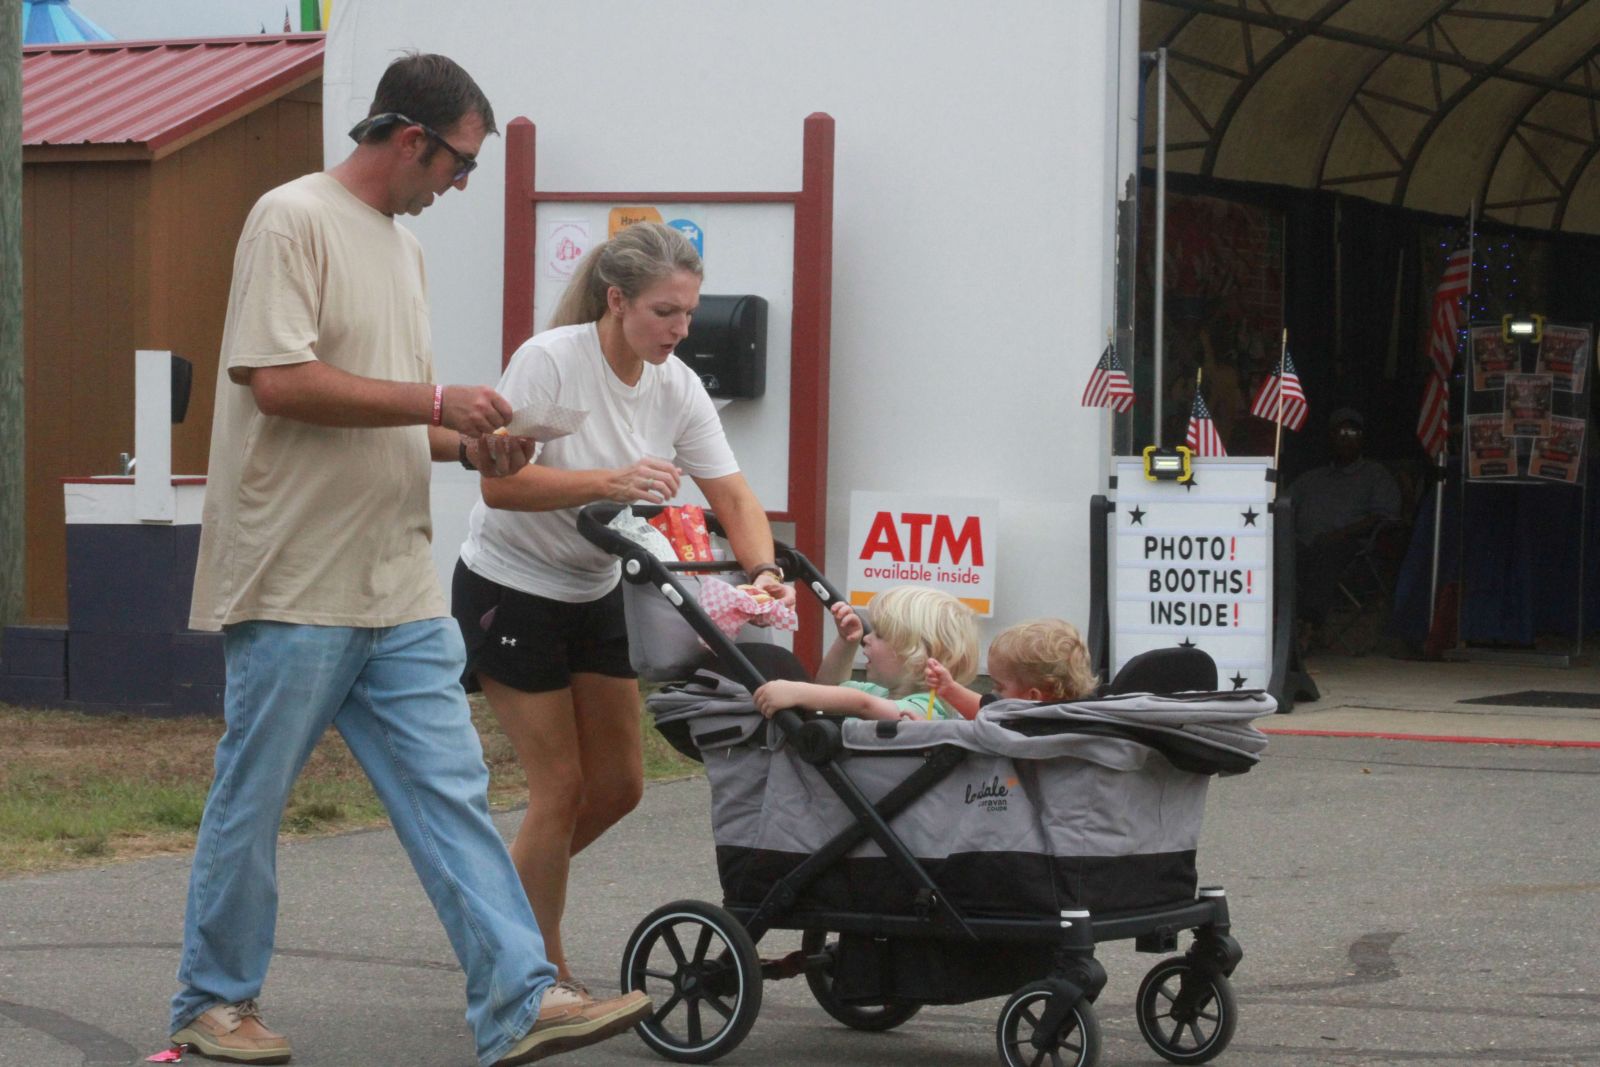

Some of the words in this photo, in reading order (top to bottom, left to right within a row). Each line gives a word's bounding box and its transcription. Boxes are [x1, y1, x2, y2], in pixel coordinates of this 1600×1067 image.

[859, 511, 984, 567] ATM
[1144, 535, 1236, 561] PHOTO!
[863, 563, 932, 581] available
[937, 566, 980, 584] inside
[1149, 568, 1252, 594] BOOTHS!
[1150, 601, 1239, 627] INSIDE!
